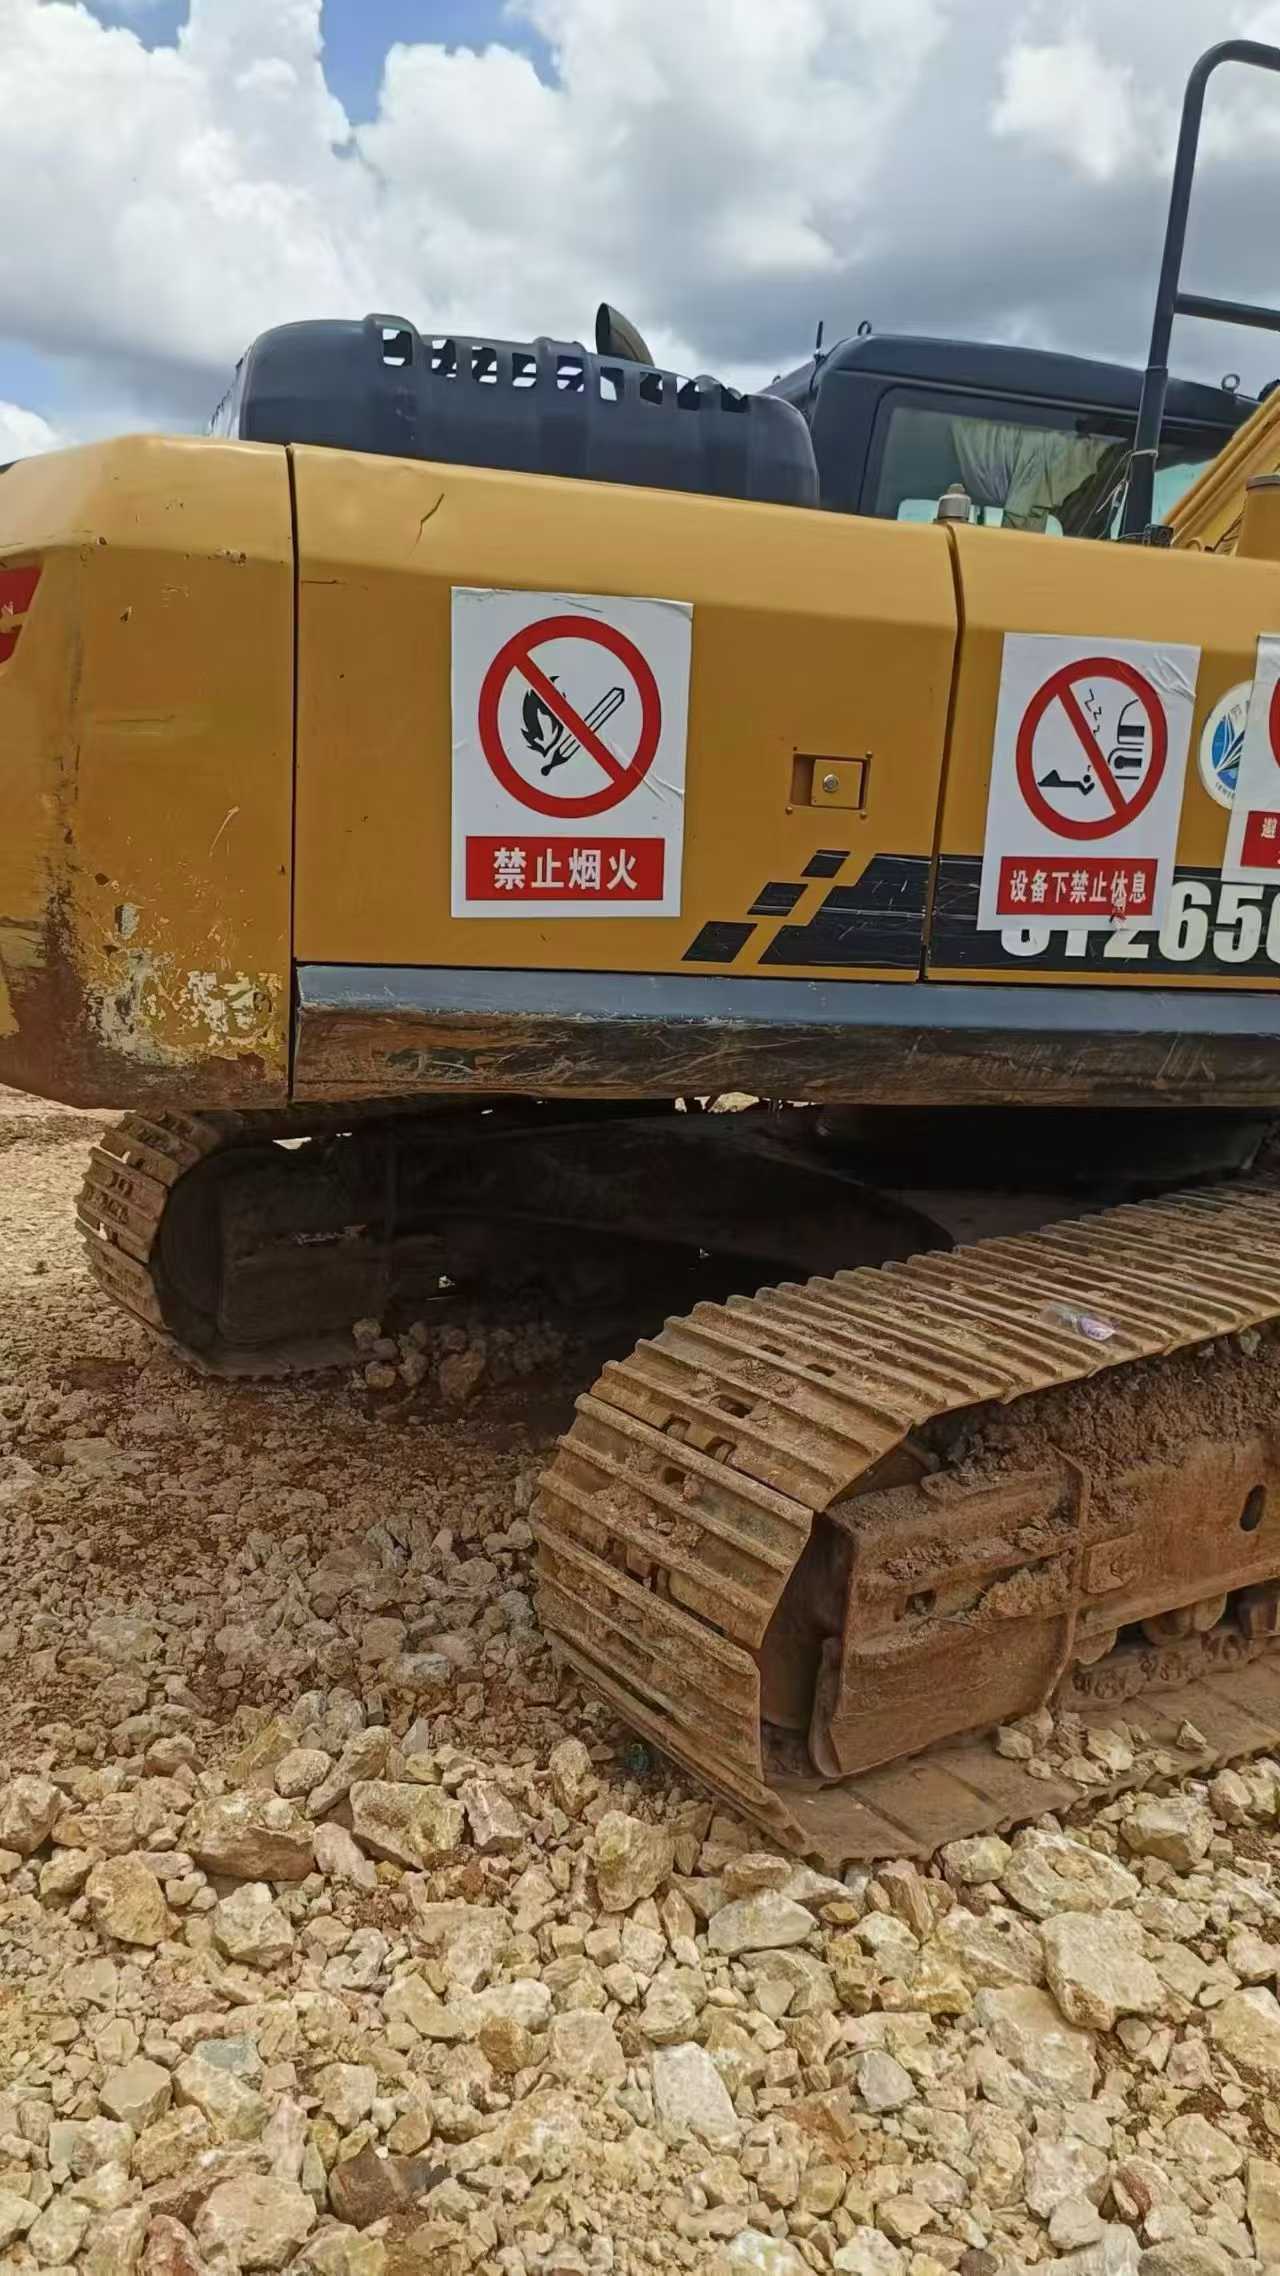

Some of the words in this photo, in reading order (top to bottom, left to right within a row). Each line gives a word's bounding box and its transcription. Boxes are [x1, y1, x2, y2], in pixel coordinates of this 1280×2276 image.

[493, 847, 639, 890] 禁止烟火
[1010, 869, 1147, 904] 设备下禁止休息
